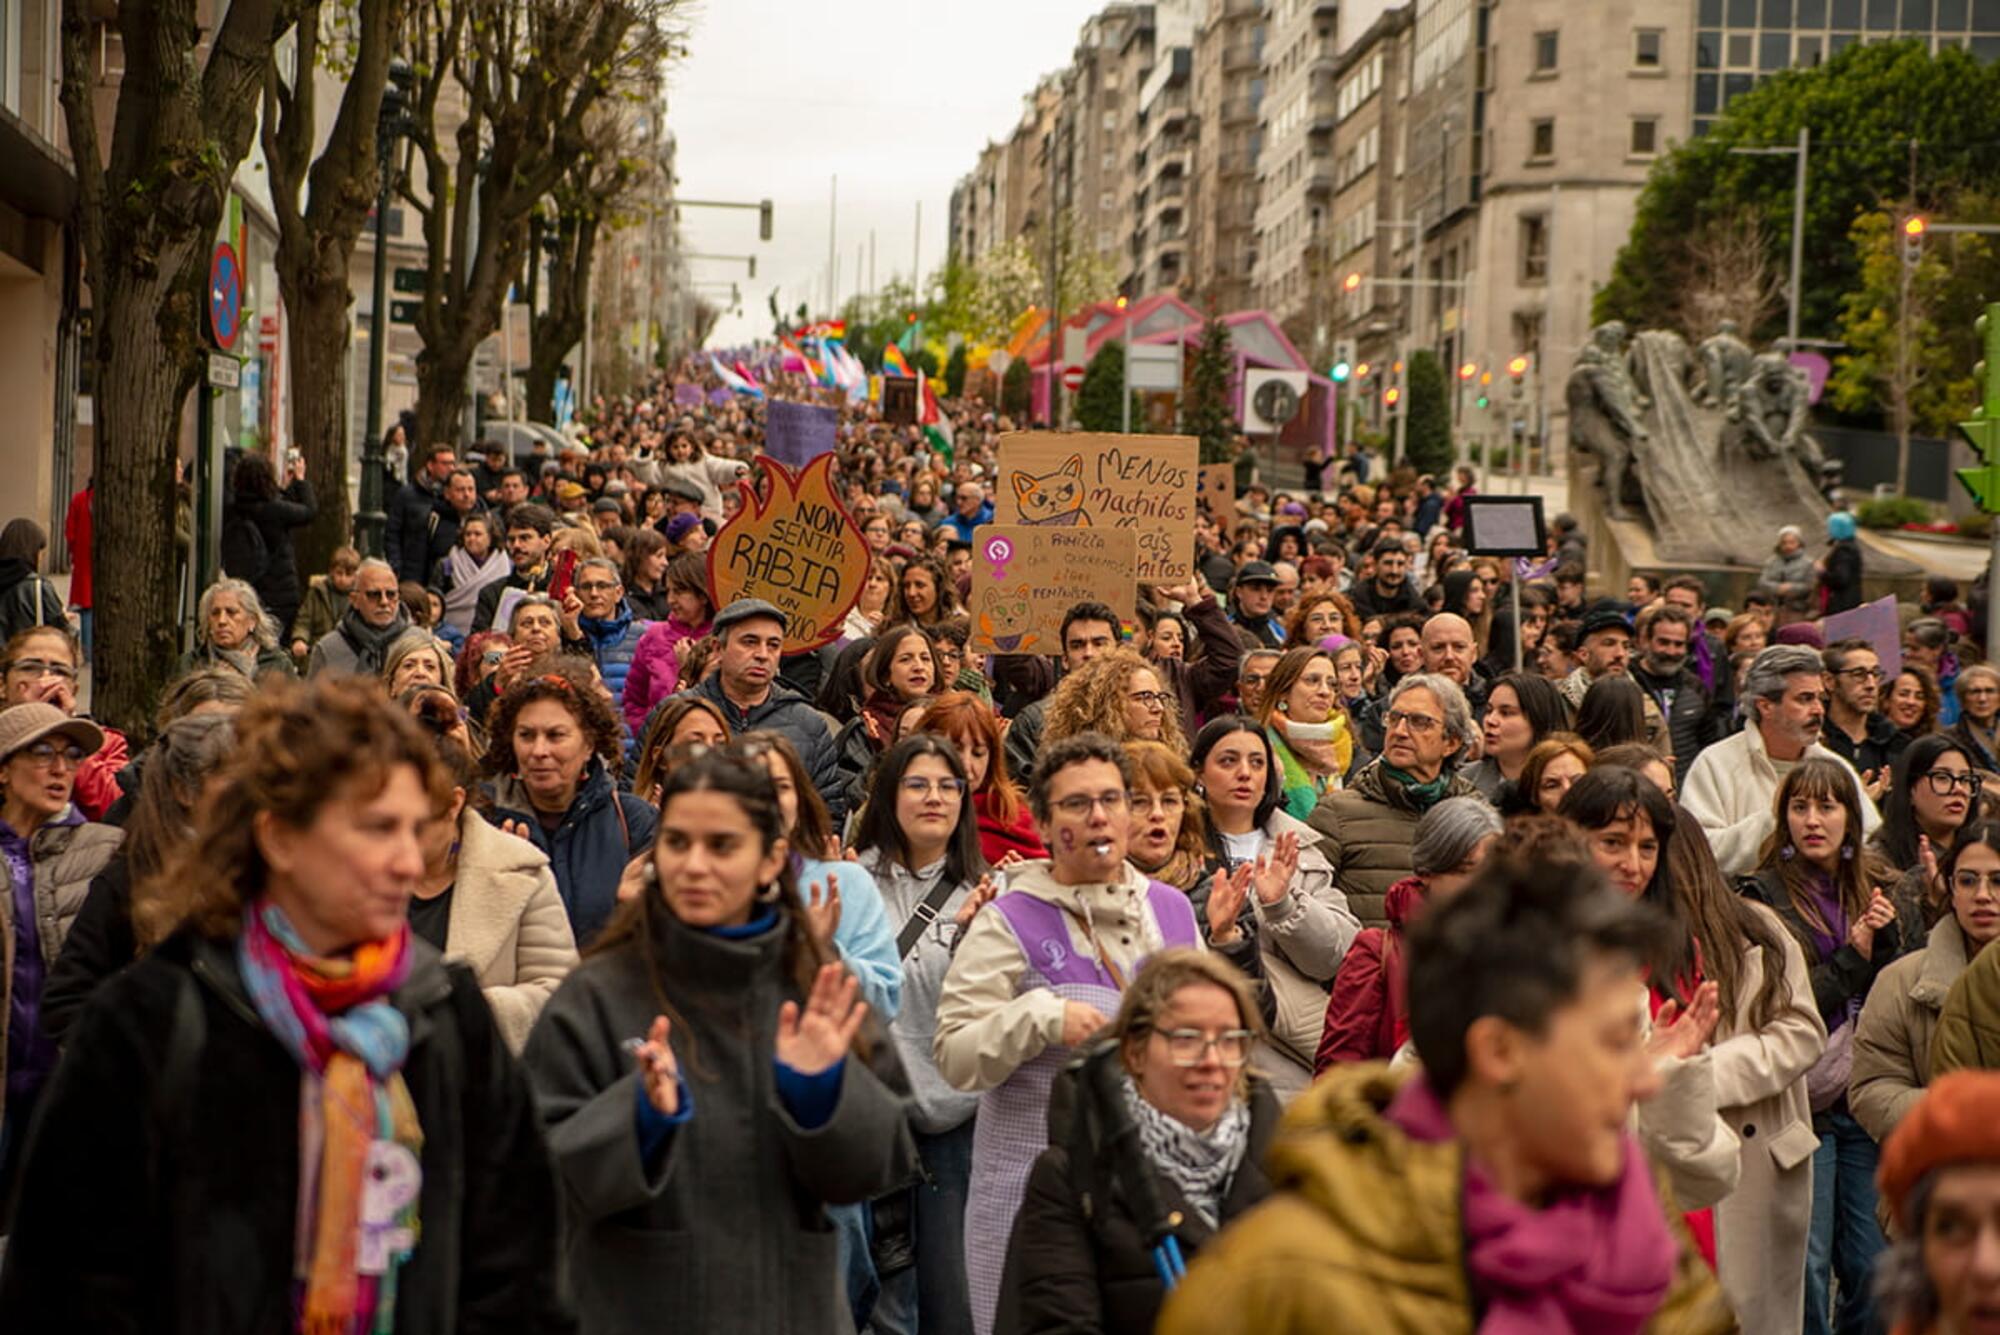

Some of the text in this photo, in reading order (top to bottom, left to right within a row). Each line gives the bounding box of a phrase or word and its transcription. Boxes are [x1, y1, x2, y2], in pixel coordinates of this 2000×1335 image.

[796, 501, 845, 538] NON
[769, 519, 845, 564] SENTIR
[730, 533, 840, 604] RABIA
[777, 593, 800, 610] UN
